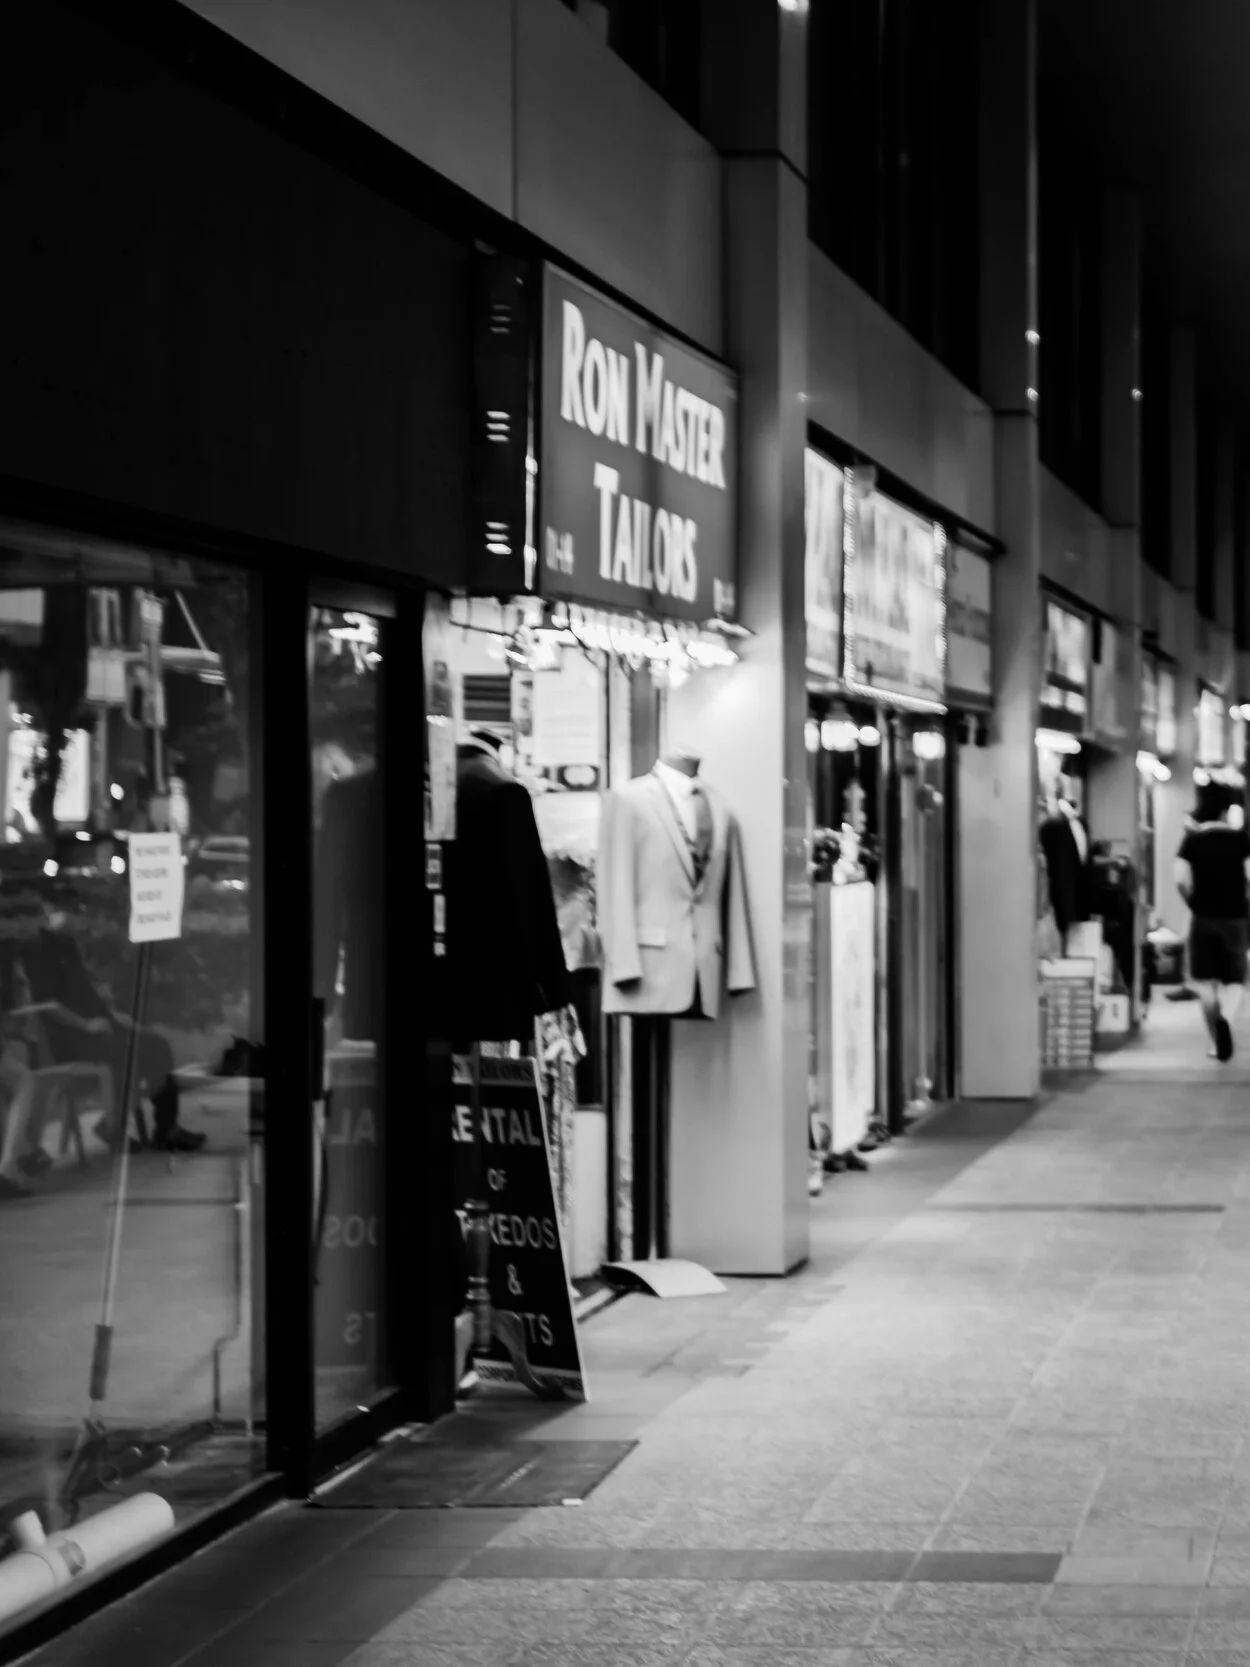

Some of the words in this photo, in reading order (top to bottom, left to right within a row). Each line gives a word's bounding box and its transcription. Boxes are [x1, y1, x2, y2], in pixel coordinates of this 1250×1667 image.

[560, 299, 629, 447] RON
[634, 340, 727, 490] MASTER
[593, 461, 698, 605] TAILORS
[451, 1104, 541, 1146] ENTAL
[487, 1167, 507, 1192] OF
[506, 1263, 524, 1295] &
